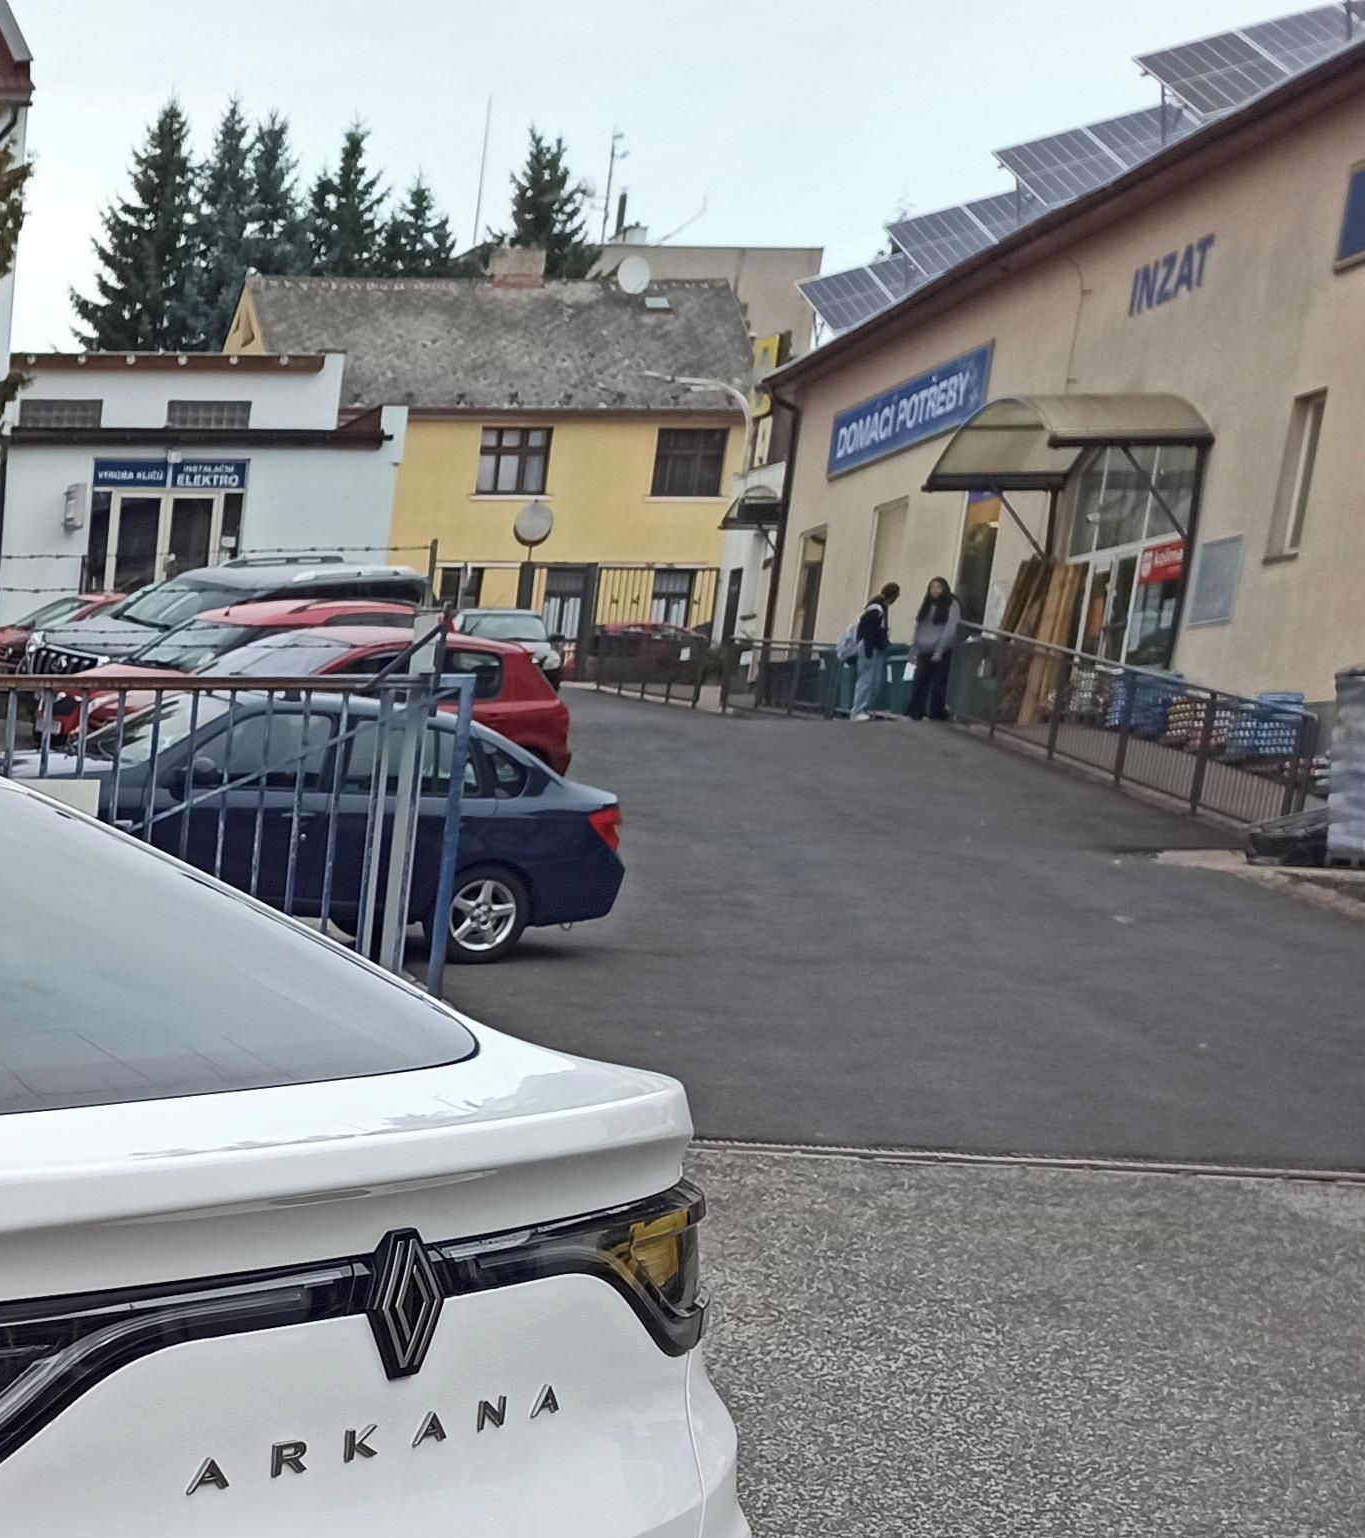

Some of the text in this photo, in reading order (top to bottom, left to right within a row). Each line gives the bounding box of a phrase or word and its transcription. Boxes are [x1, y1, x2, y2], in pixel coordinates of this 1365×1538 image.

[1129, 231, 1215, 317] INZAT
[836, 370, 970, 459] DOMÁCÍ POTŘEBY
[176, 473, 239, 488] ELEKTRO
[185, 1383, 560, 1496] ARKANA
